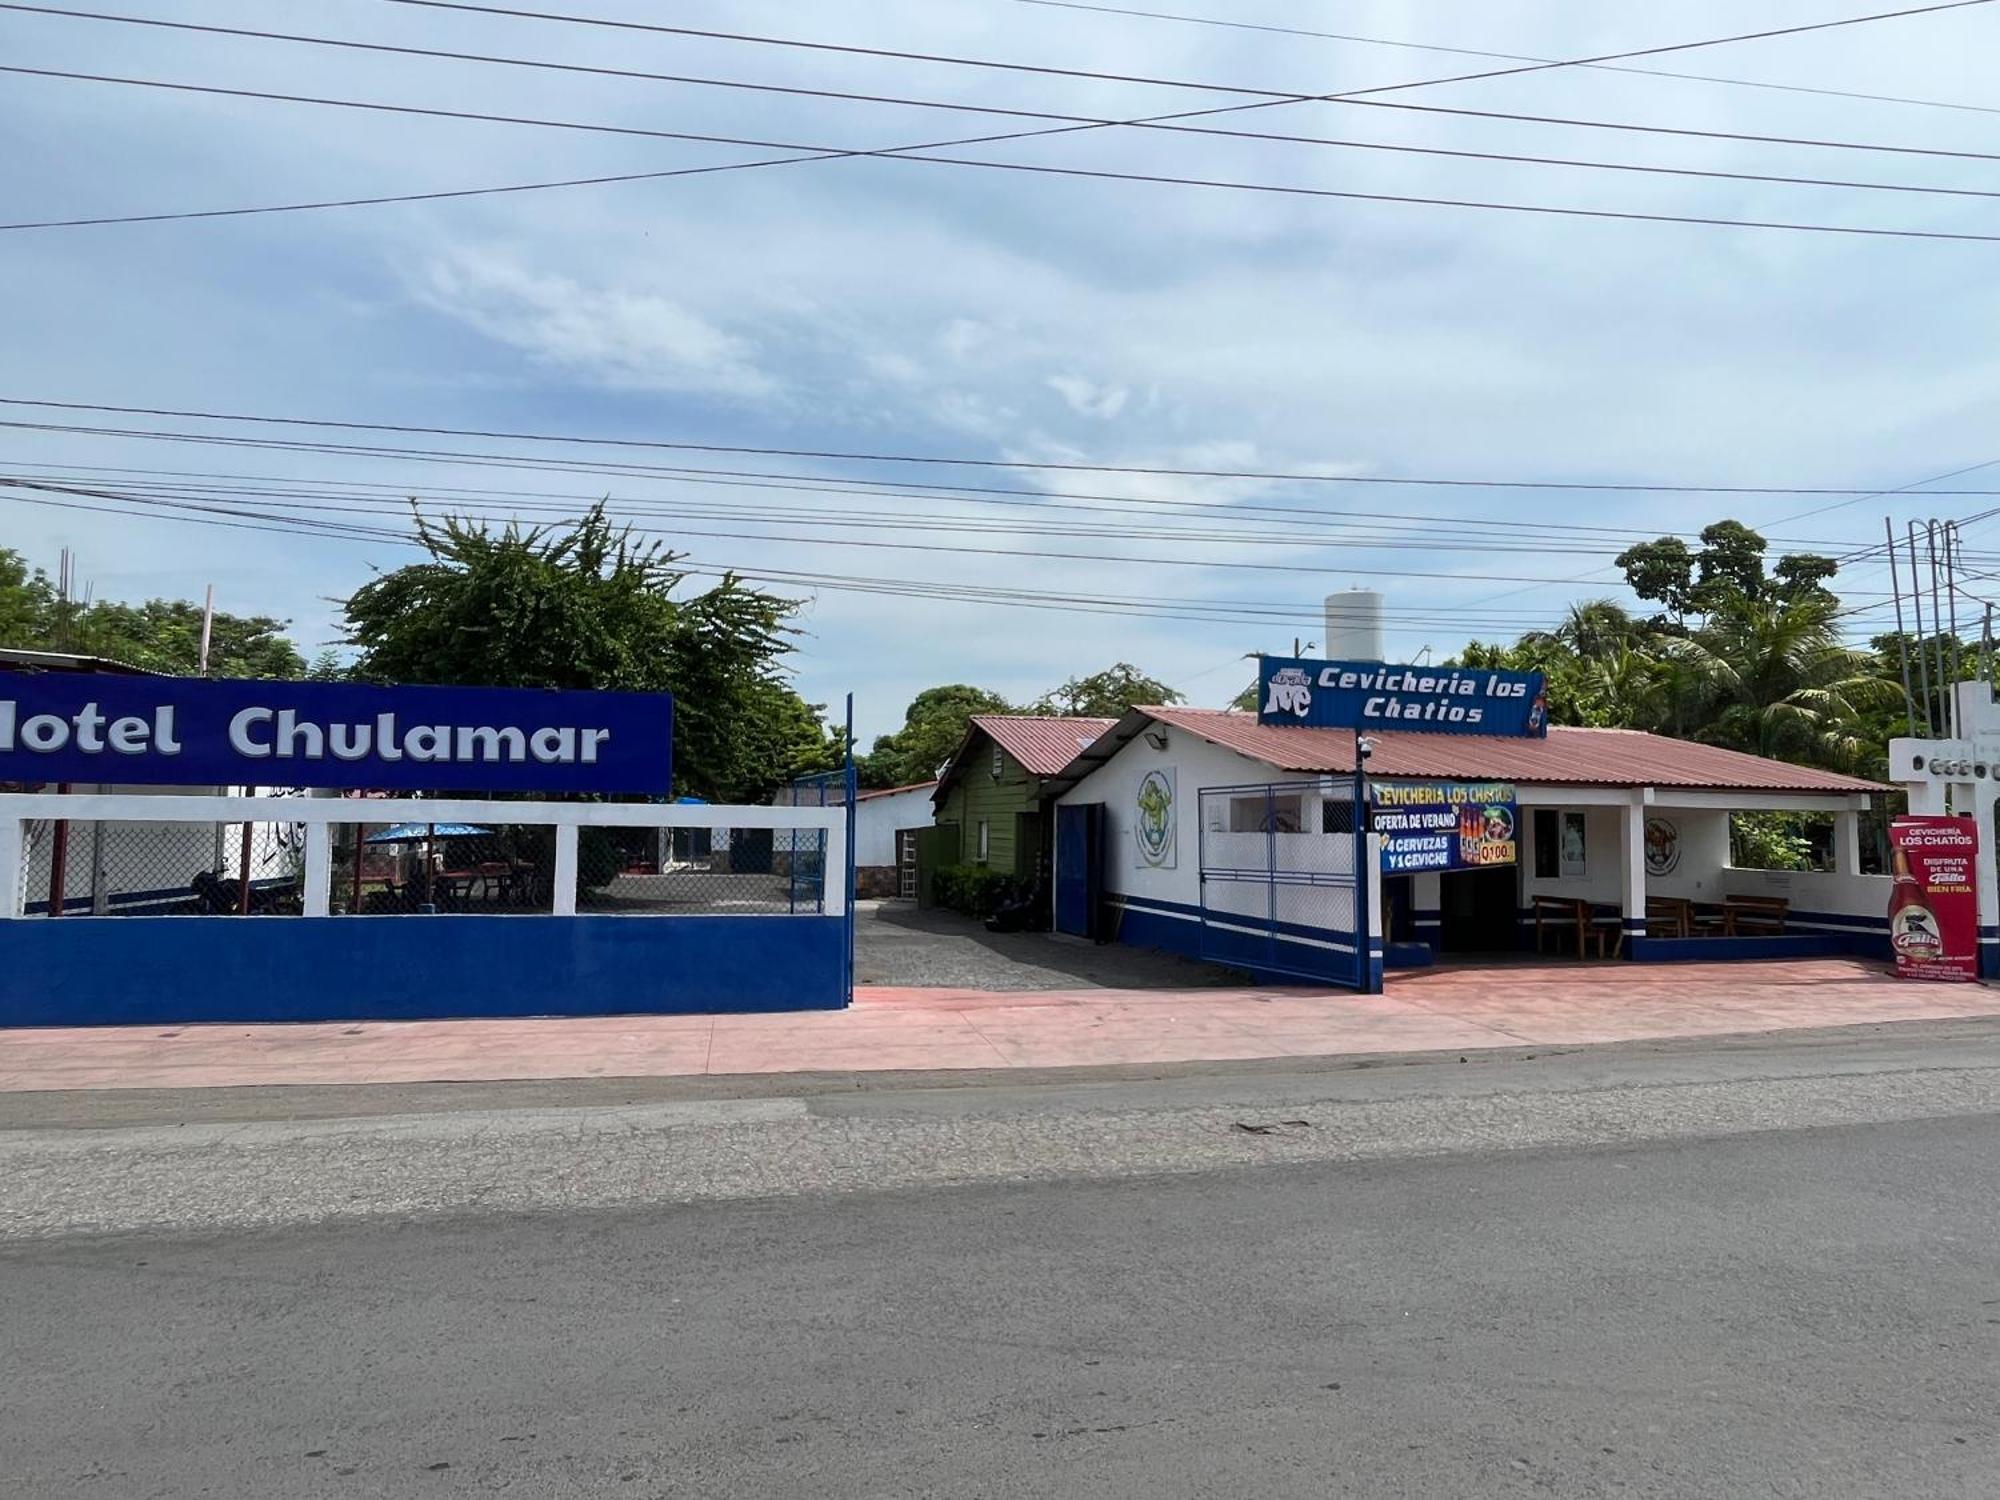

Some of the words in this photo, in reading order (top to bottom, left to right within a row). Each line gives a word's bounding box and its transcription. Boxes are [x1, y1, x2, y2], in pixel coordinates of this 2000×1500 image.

[1318, 667, 1476, 696] Cevicheria
[1486, 674, 1527, 697] los
[1363, 697, 1484, 722] Chatios
[228, 706, 610, 763] Chulamar
[1447, 787, 1468, 804] LOS
[1374, 814, 1408, 831] OFERTA
[1409, 814, 1421, 829] DE
[1422, 813, 1456, 829] VERANO
[1387, 839, 1395, 853] 4
[1395, 836, 1448, 852] CERVEZAS
[1900, 836, 1922, 846] LOS
[1388, 854, 1396, 869] Y
[1396, 854, 1405, 868] 1
[1404, 852, 1448, 868] CEVICHE
[1923, 858, 1968, 866] DISFRUTA
[1926, 885, 1950, 893] BIEN
